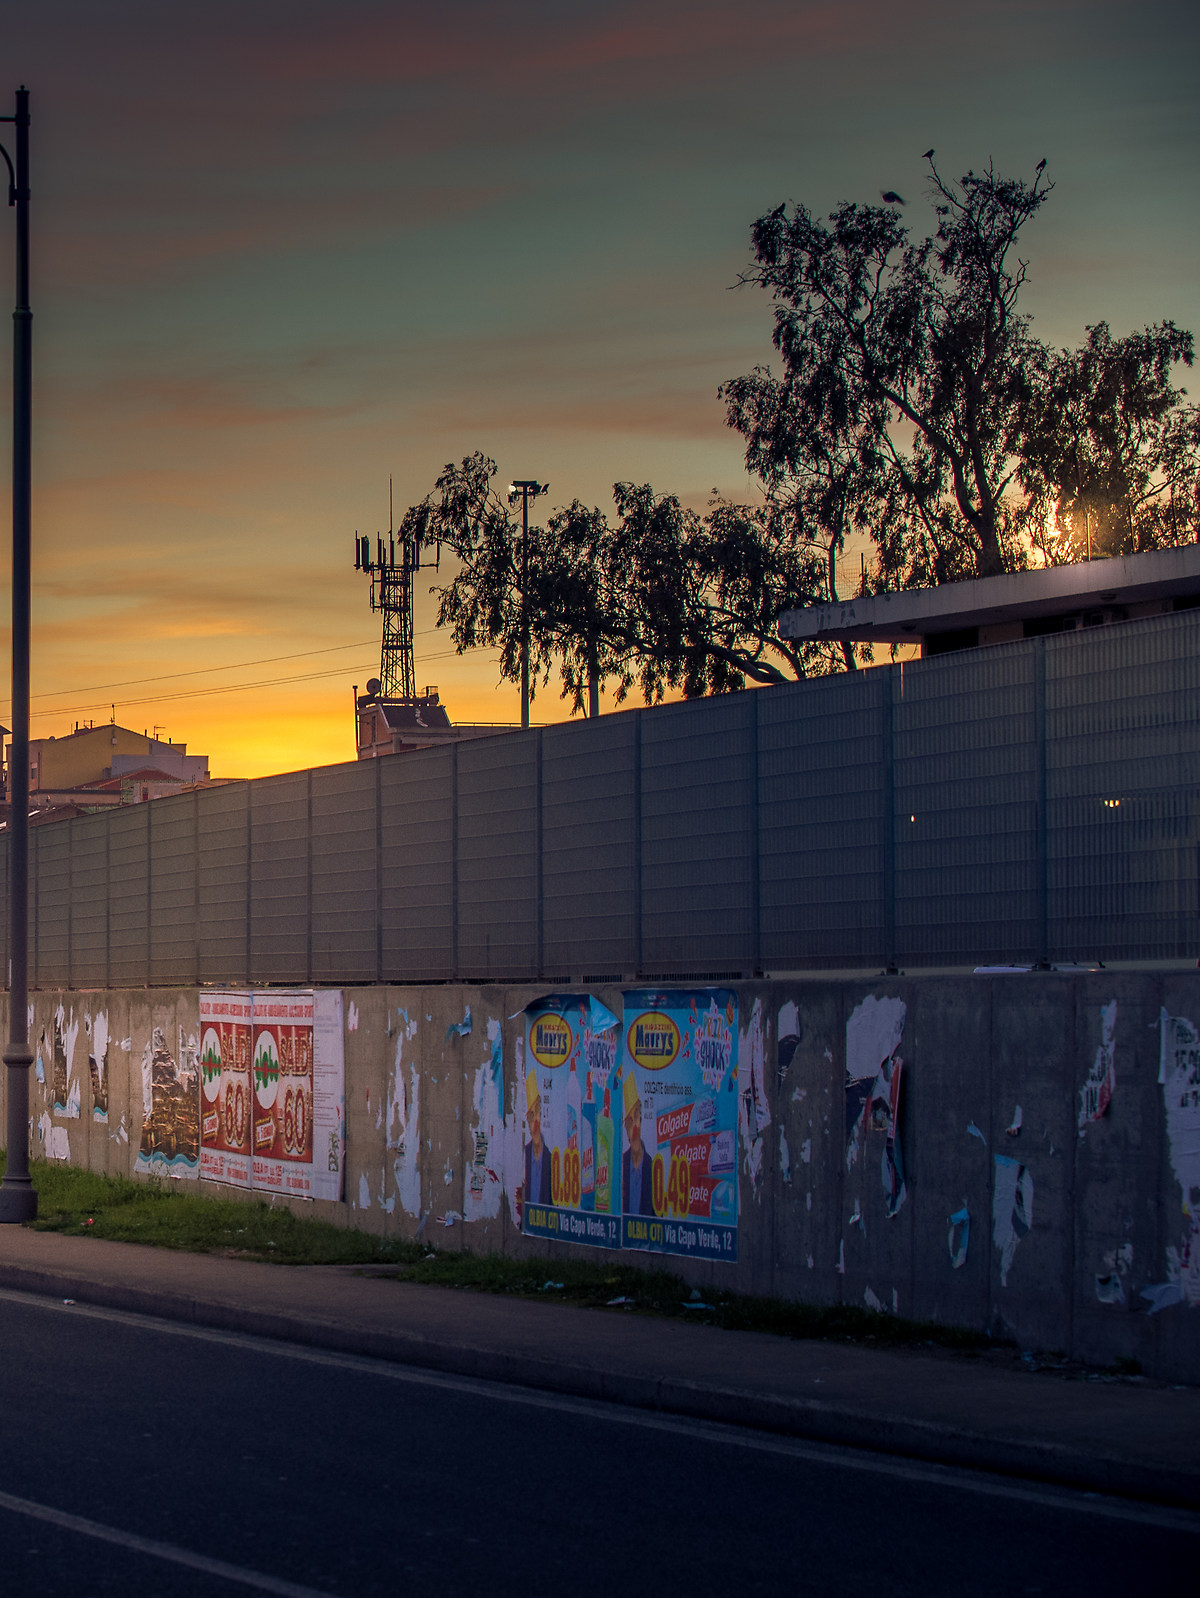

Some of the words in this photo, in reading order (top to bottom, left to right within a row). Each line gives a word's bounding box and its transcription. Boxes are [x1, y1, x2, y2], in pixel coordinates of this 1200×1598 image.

[536, 1025, 567, 1054] Maurys
[636, 1025, 673, 1055] Maurys
[700, 1041, 725, 1071] SHOCK
[658, 1113, 689, 1136] Colgate
[552, 1147, 580, 1208] 0.88
[653, 1152, 689, 1217] 0.49
[689, 1186, 708, 1204] gate
[529, 1208, 546, 1226] OLBIA
[560, 1214, 569, 1232] Via
[570, 1215, 586, 1237] Capo
[587, 1218, 606, 1239] Verde,
[608, 1221, 617, 1239] 12
[628, 1220, 648, 1240] OLBIA
[665, 1224, 677, 1244] Via
[678, 1226, 696, 1249] Capo
[698, 1228, 721, 1251] Verde,
[722, 1232, 732, 1250] 12
